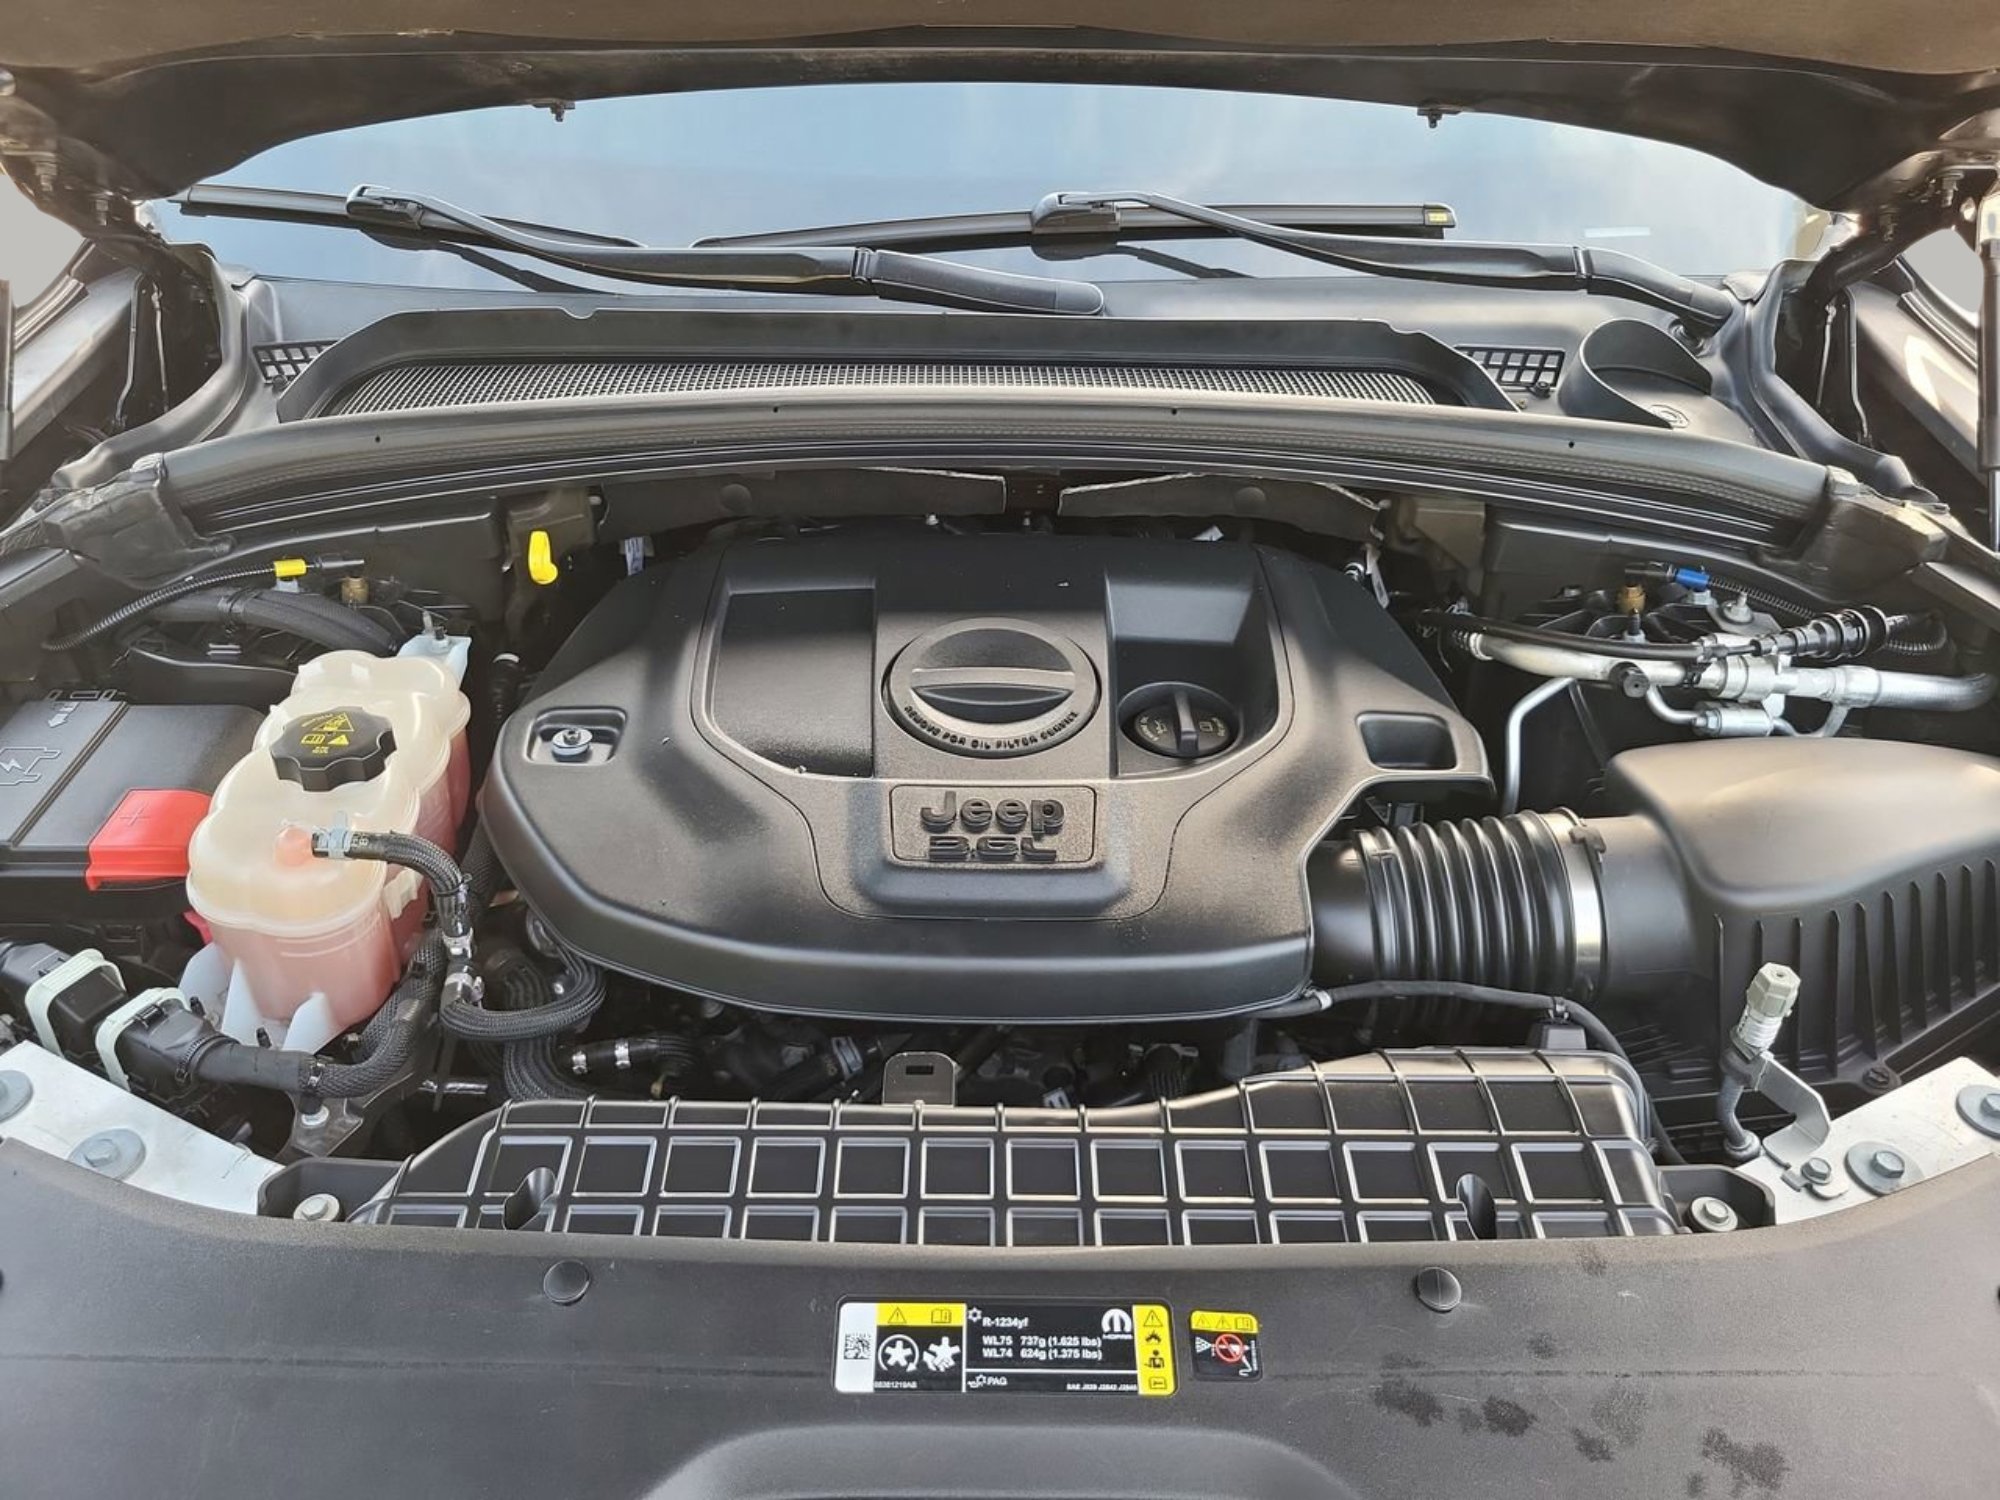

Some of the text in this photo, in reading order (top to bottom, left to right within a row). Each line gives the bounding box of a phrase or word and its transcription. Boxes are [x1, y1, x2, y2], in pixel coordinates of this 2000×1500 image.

[942, 731, 967, 746] FOR
[971, 738, 991, 750] OIL
[996, 736, 1038, 749] FILTER
[920, 790, 1065, 838] Jeep
[982, 1316, 1029, 1330] R-1234yf
[982, 1335, 1102, 1348] WL75 737g (1.625 lbs)
[982, 1347, 1103, 1360] WL74 624g (1.375 lbs)
[986, 1376, 1008, 1386] PAG
